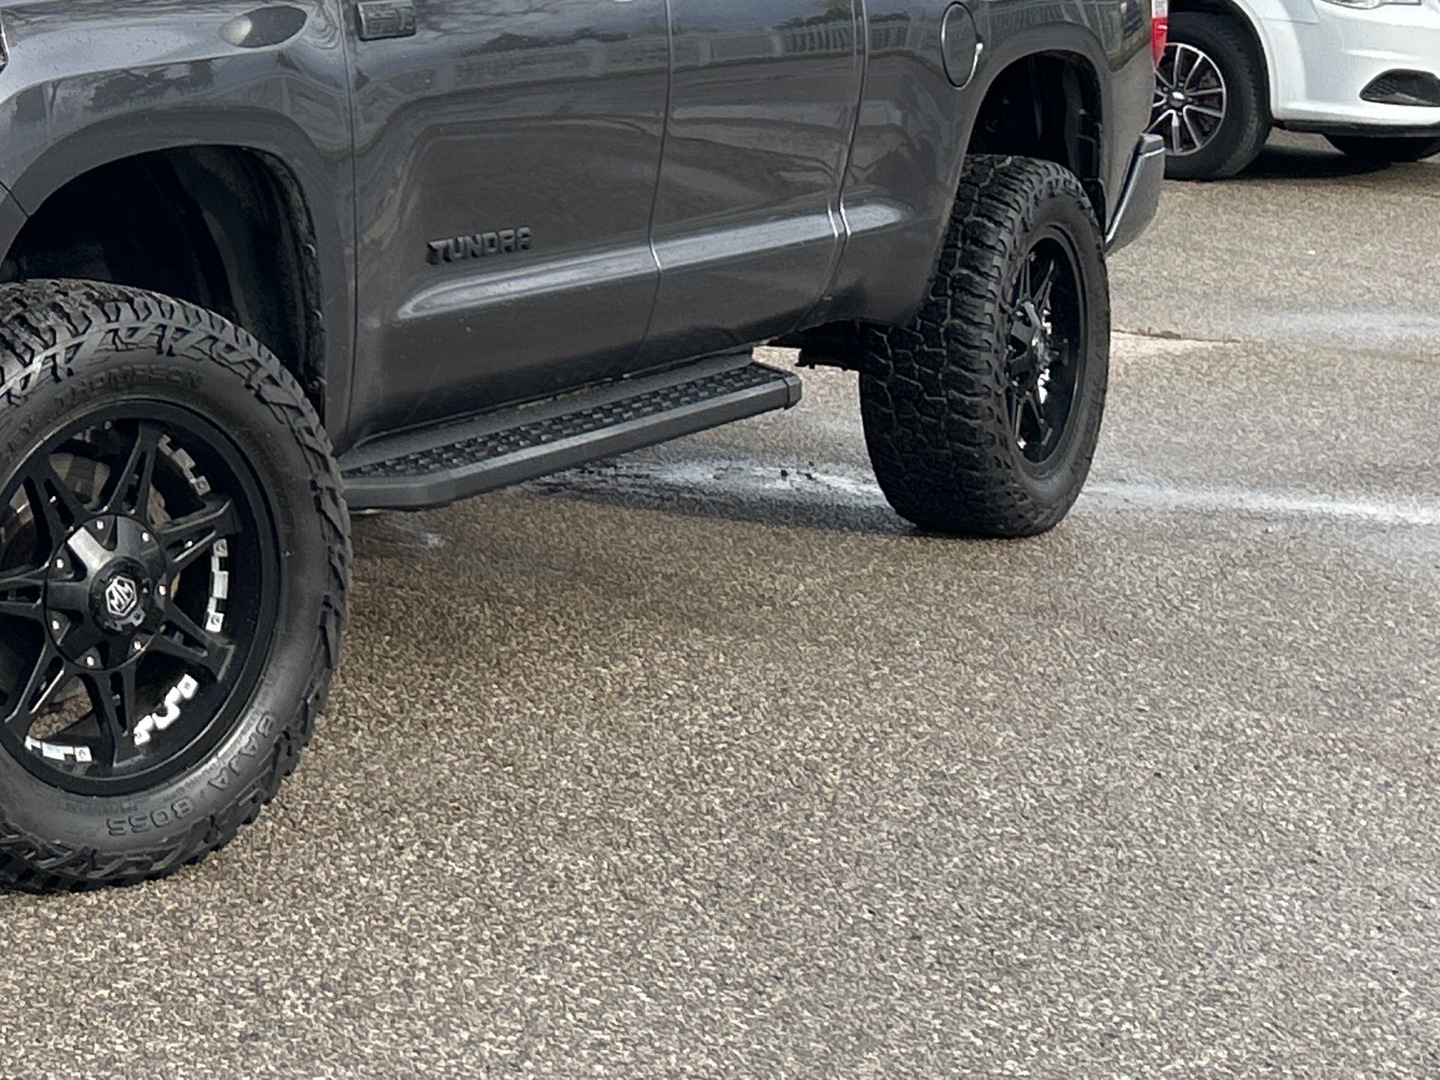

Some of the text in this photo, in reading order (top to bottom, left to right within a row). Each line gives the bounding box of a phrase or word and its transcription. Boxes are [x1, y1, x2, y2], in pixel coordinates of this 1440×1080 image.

[426, 226, 531, 265] TUNDRA
[207, 710, 276, 791] BAJA
[106, 796, 214, 837] BOSS
